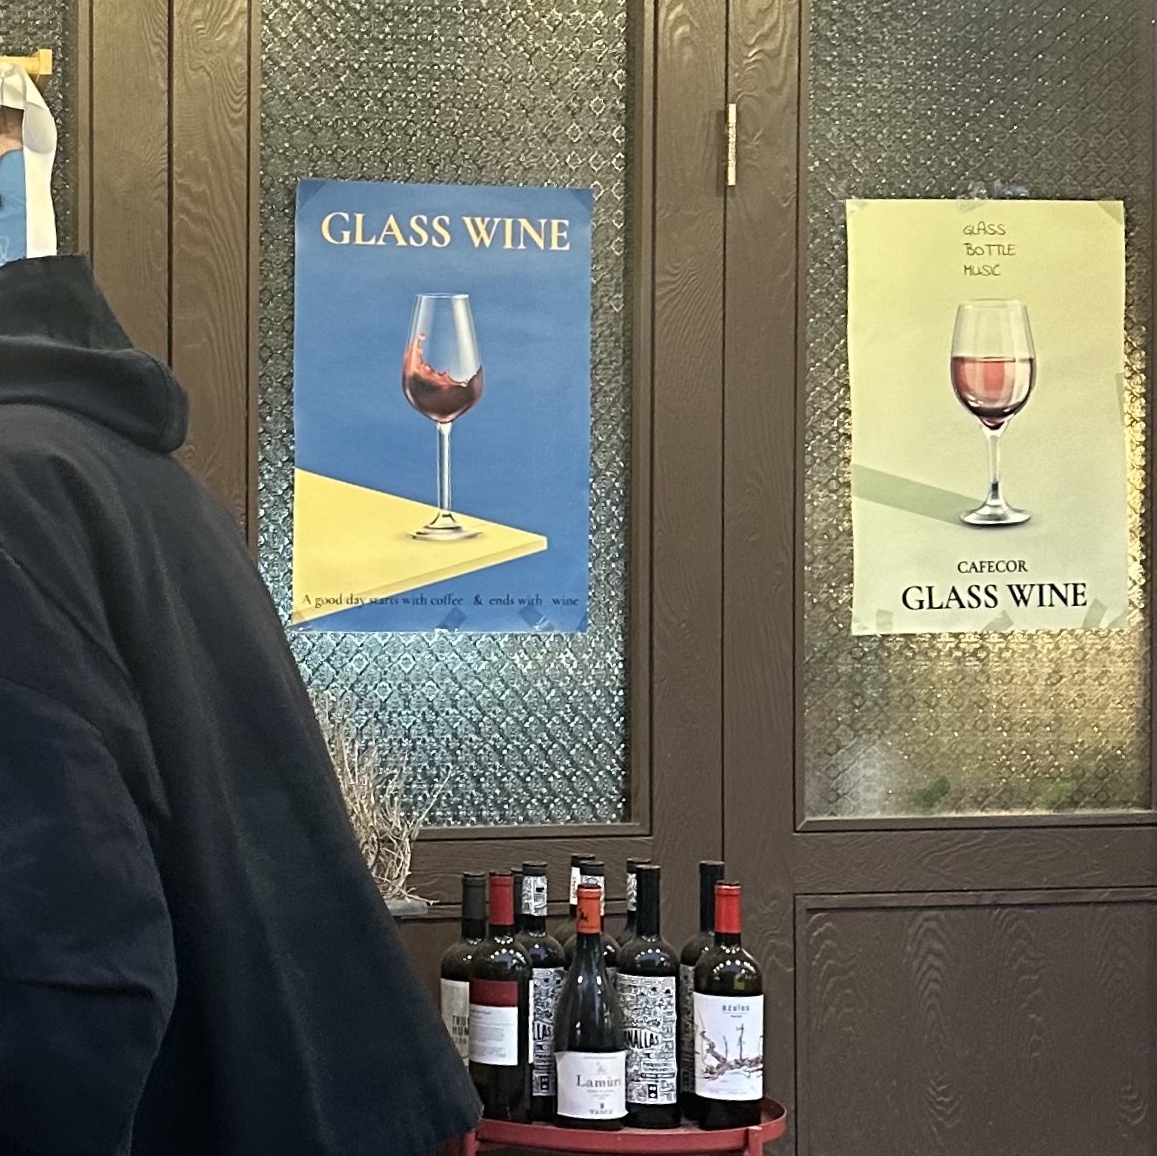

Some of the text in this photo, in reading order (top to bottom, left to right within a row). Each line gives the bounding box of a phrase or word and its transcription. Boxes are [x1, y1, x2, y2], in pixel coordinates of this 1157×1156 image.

[320, 211, 571, 251] GLASS WINE
[963, 220, 1006, 236] GLASS
[963, 242, 1016, 256] BOTTLE
[963, 264, 1001, 276] MUSIC
[957, 560, 1028, 574] CAFECOR
[302, 592, 580, 609] A good day starts with coffee & ends with wine
[901, 582, 1088, 610] GLASS WINE
